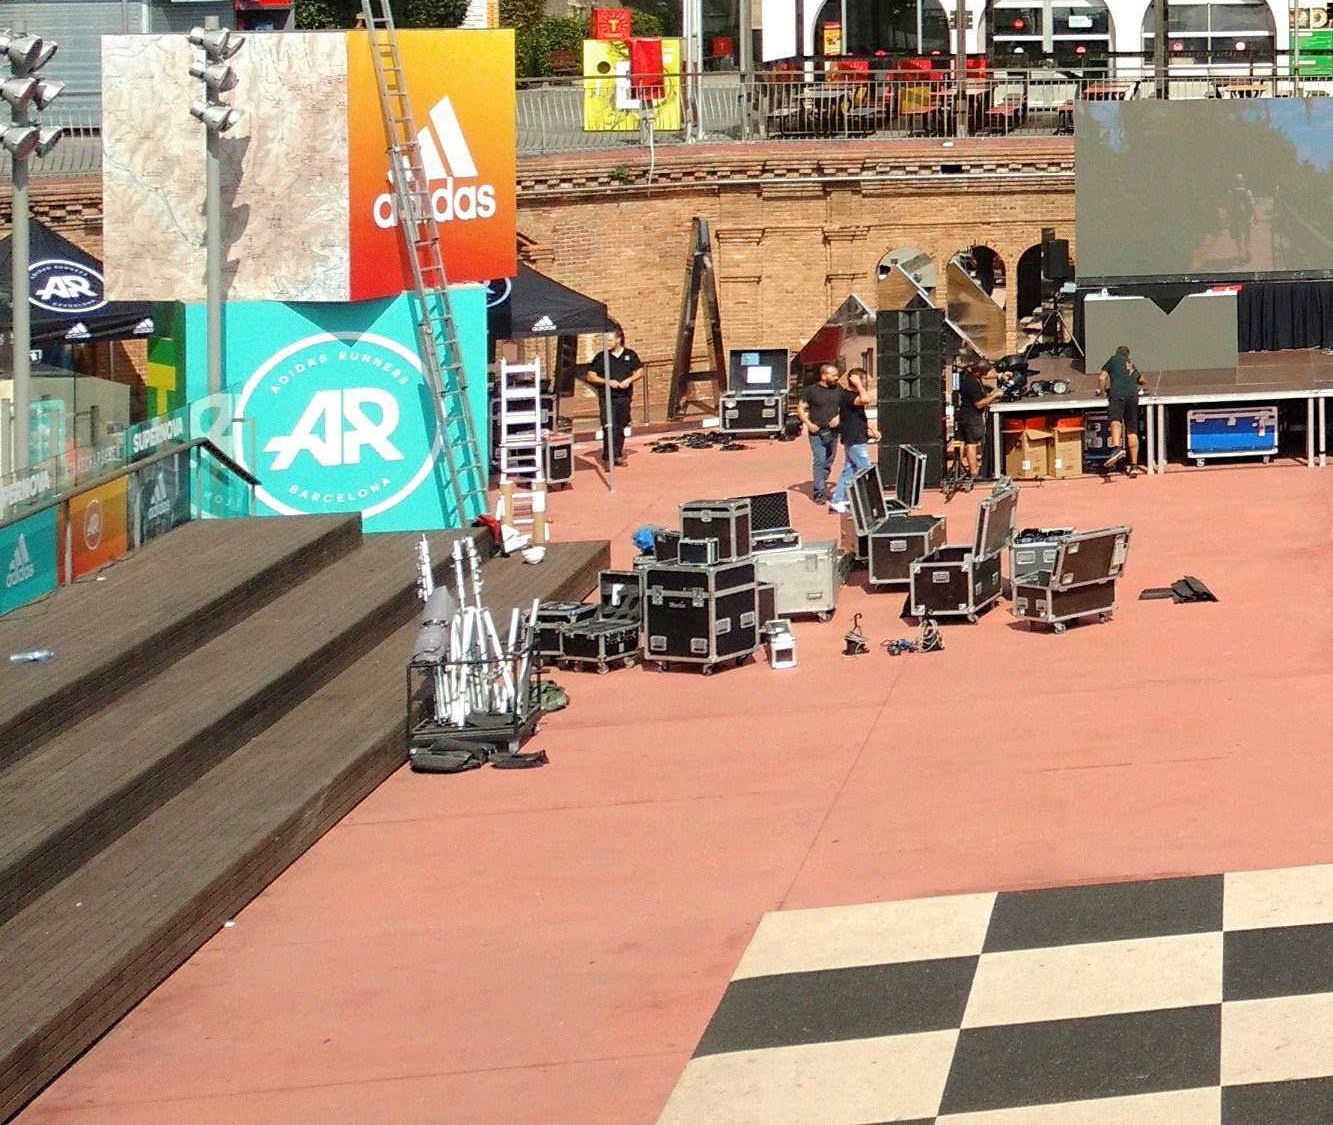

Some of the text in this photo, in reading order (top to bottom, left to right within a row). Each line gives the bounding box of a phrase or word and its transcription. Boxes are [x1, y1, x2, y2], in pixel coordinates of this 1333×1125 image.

[270, 351, 409, 395] ADIDAS RUNNERS
[262, 387, 405, 471] AR
[288, 477, 392, 504] BARCELONA
